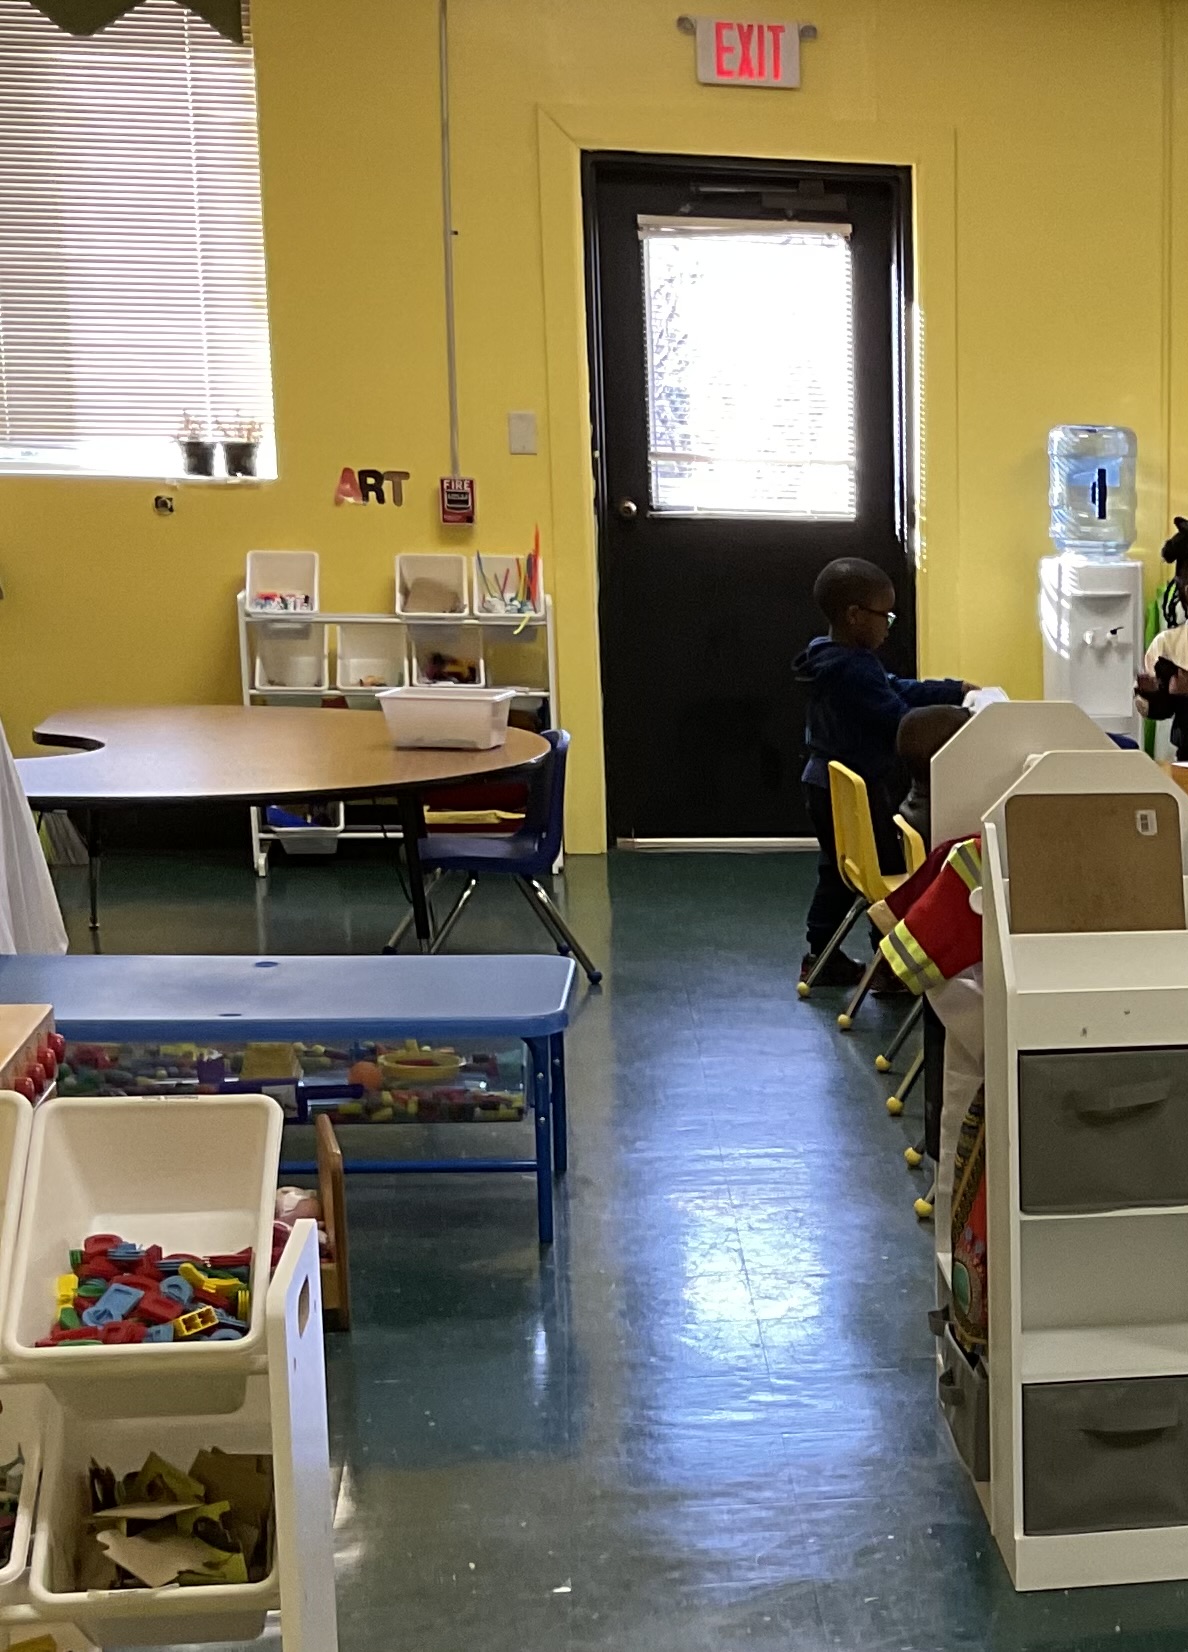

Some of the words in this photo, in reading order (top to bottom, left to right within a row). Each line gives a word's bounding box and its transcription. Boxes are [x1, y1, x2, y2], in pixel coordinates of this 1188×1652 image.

[715, 22, 785, 80] EXIT
[334, 467, 410, 507] ART
[443, 479, 471, 491] FIRE
